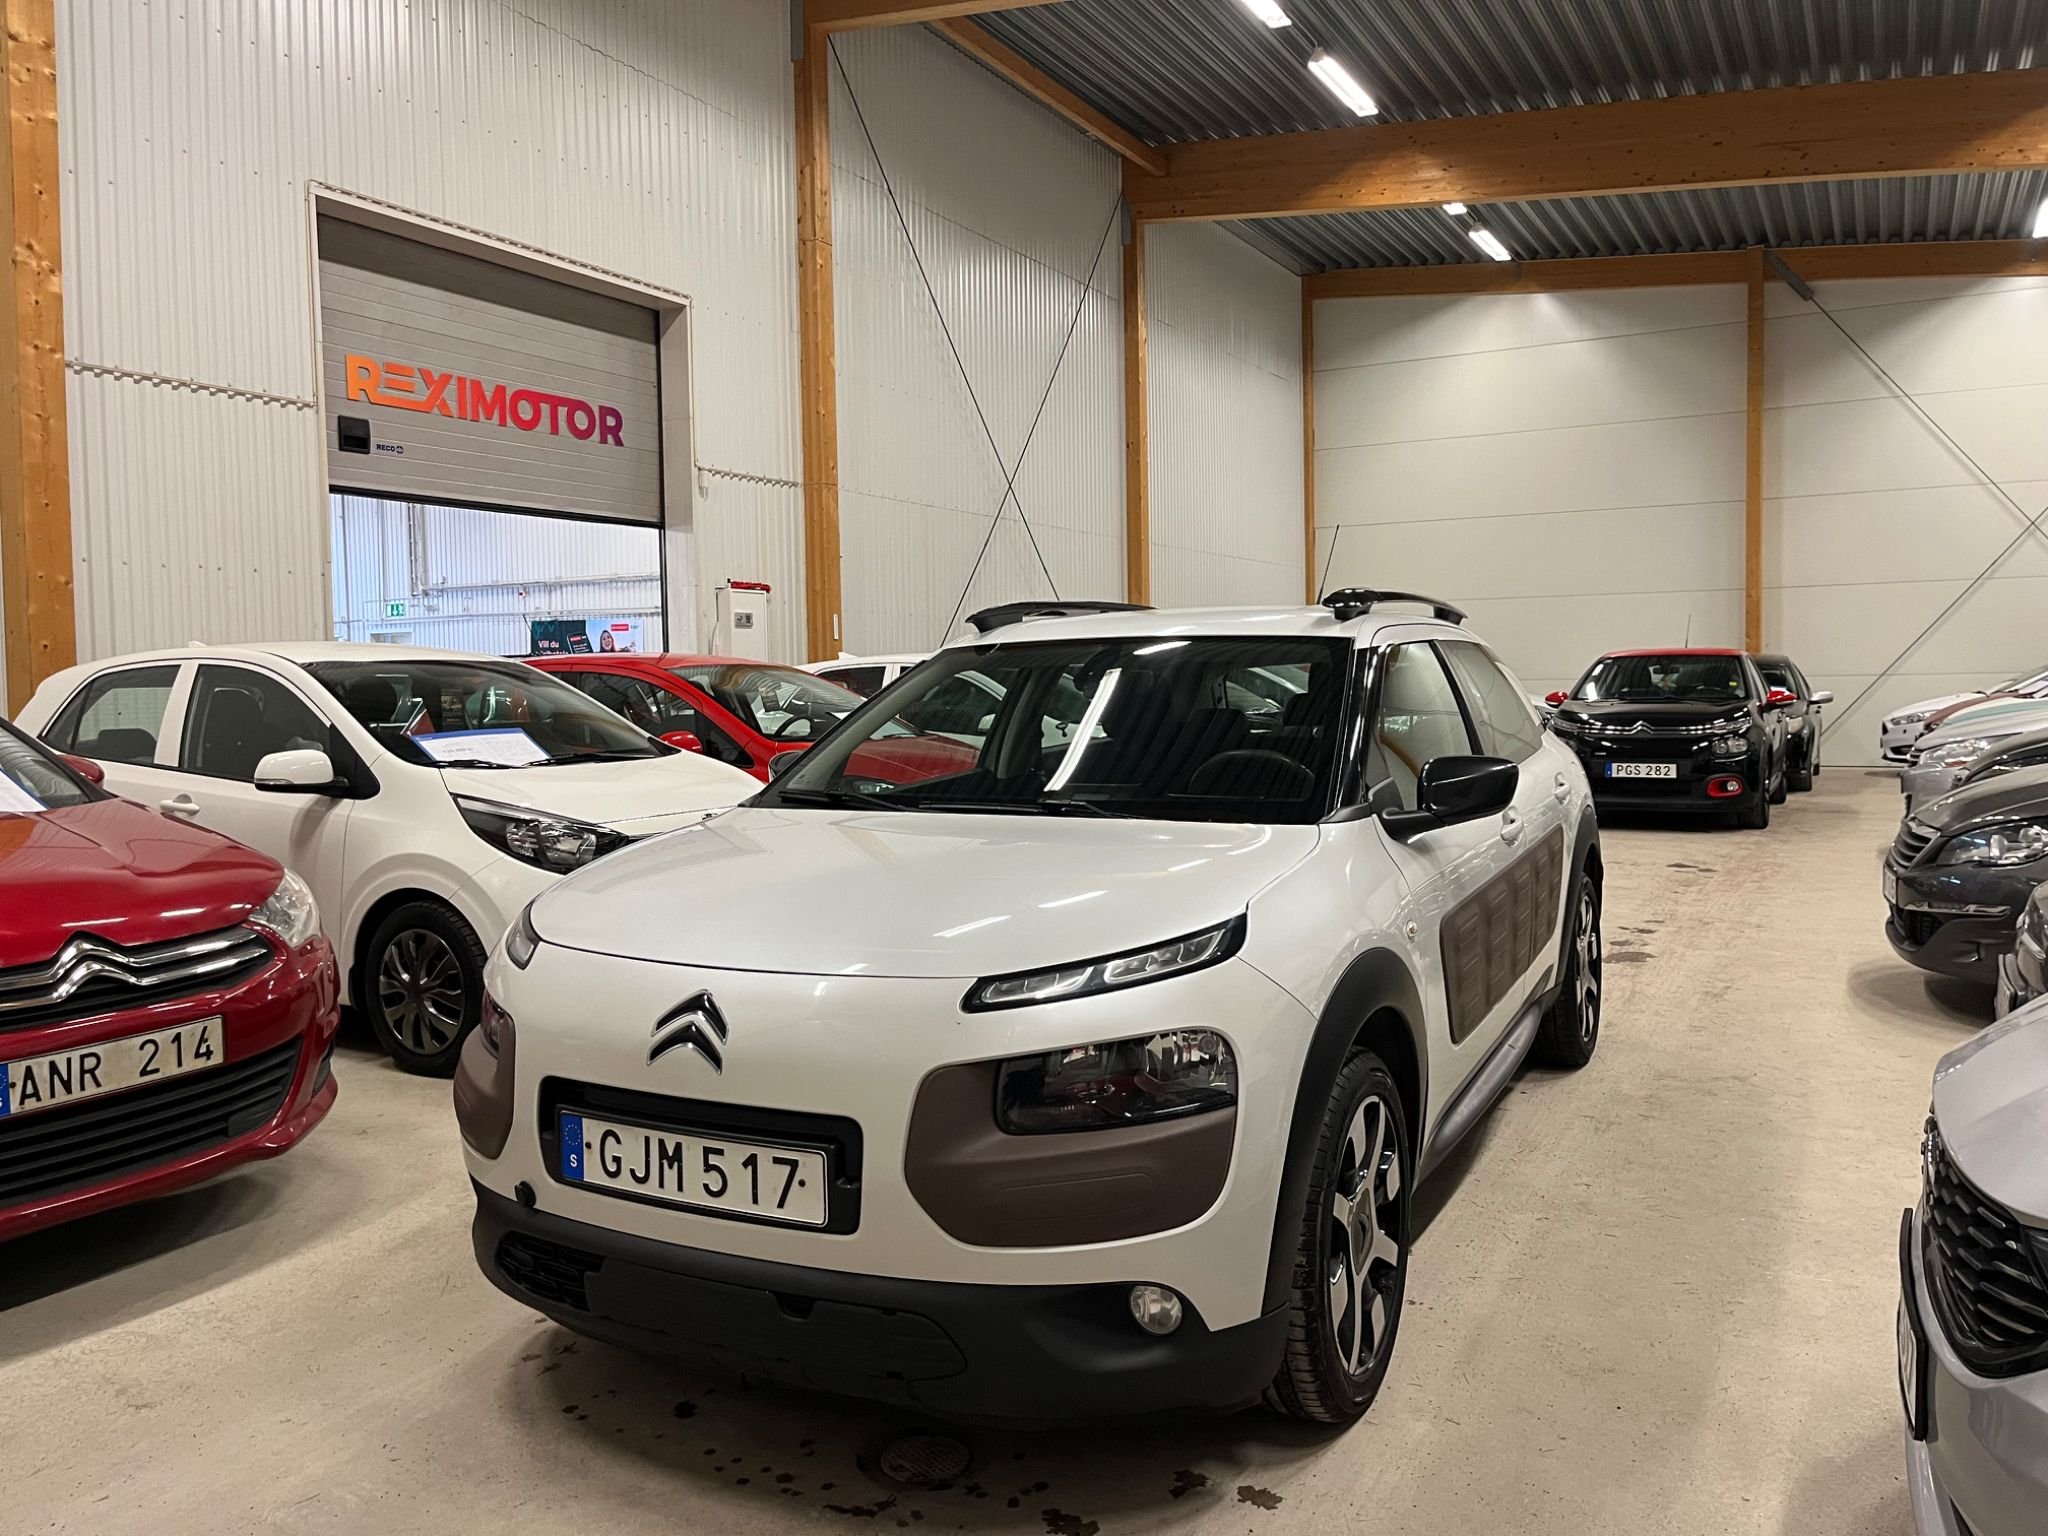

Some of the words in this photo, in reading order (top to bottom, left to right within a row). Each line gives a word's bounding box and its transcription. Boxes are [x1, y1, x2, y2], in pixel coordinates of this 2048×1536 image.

[345, 353, 624, 447] REXIMOTOR
[376, 443, 396, 452] RECO
[550, 640, 560, 648] du
[1616, 764, 1641, 776] PGS
[1645, 765, 1671, 777] 282
[19, 1052, 102, 1106] ANR
[138, 1025, 214, 1078] 214
[569, 1153, 578, 1168] S
[600, 1128, 684, 1193] GJM
[702, 1145, 800, 1209] 517
